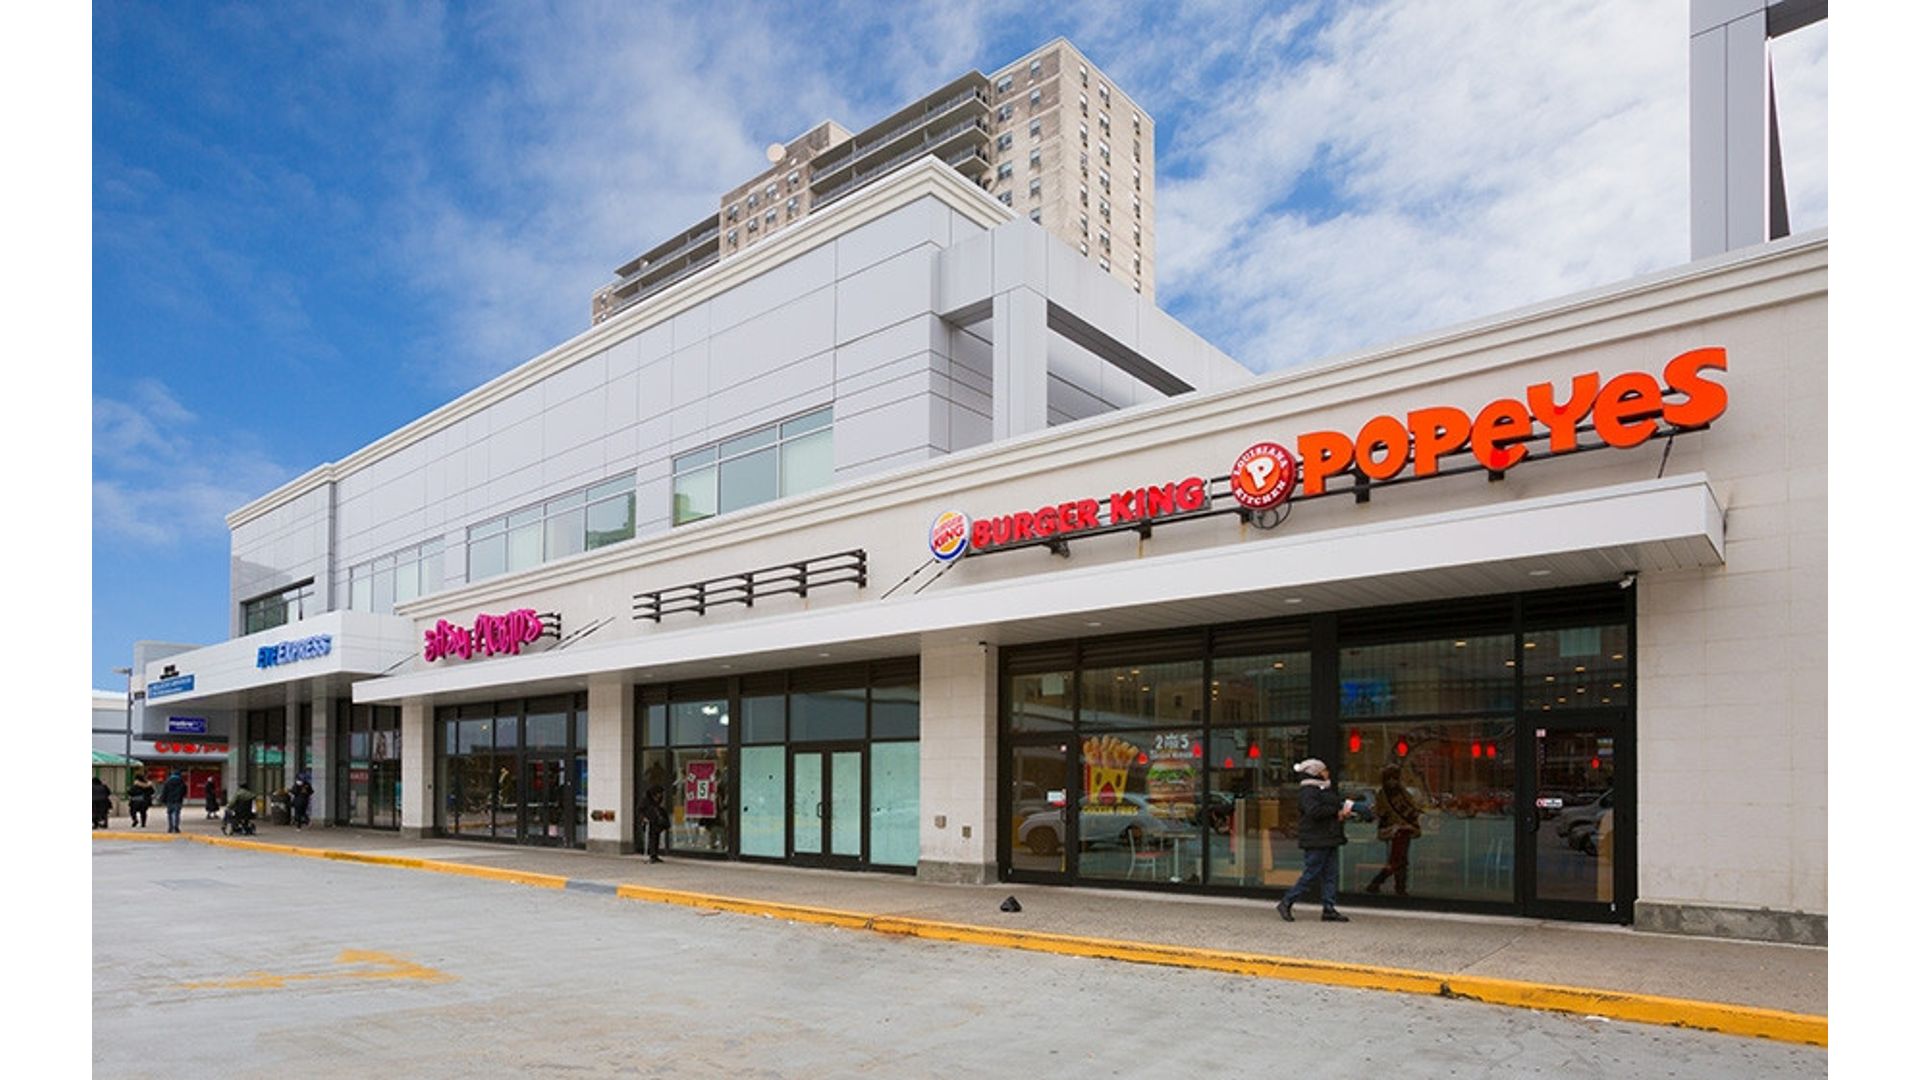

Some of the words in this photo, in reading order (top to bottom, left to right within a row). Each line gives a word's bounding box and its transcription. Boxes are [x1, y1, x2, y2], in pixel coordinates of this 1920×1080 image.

[1234, 446, 1288, 475] LOUISIANA
[1246, 456, 1275, 490] P
[1235, 480, 1286, 505] KITCHEN
[971, 498, 1100, 549] BURGER
[1109, 477, 1206, 524] KING
[933, 524, 965, 549] KING
